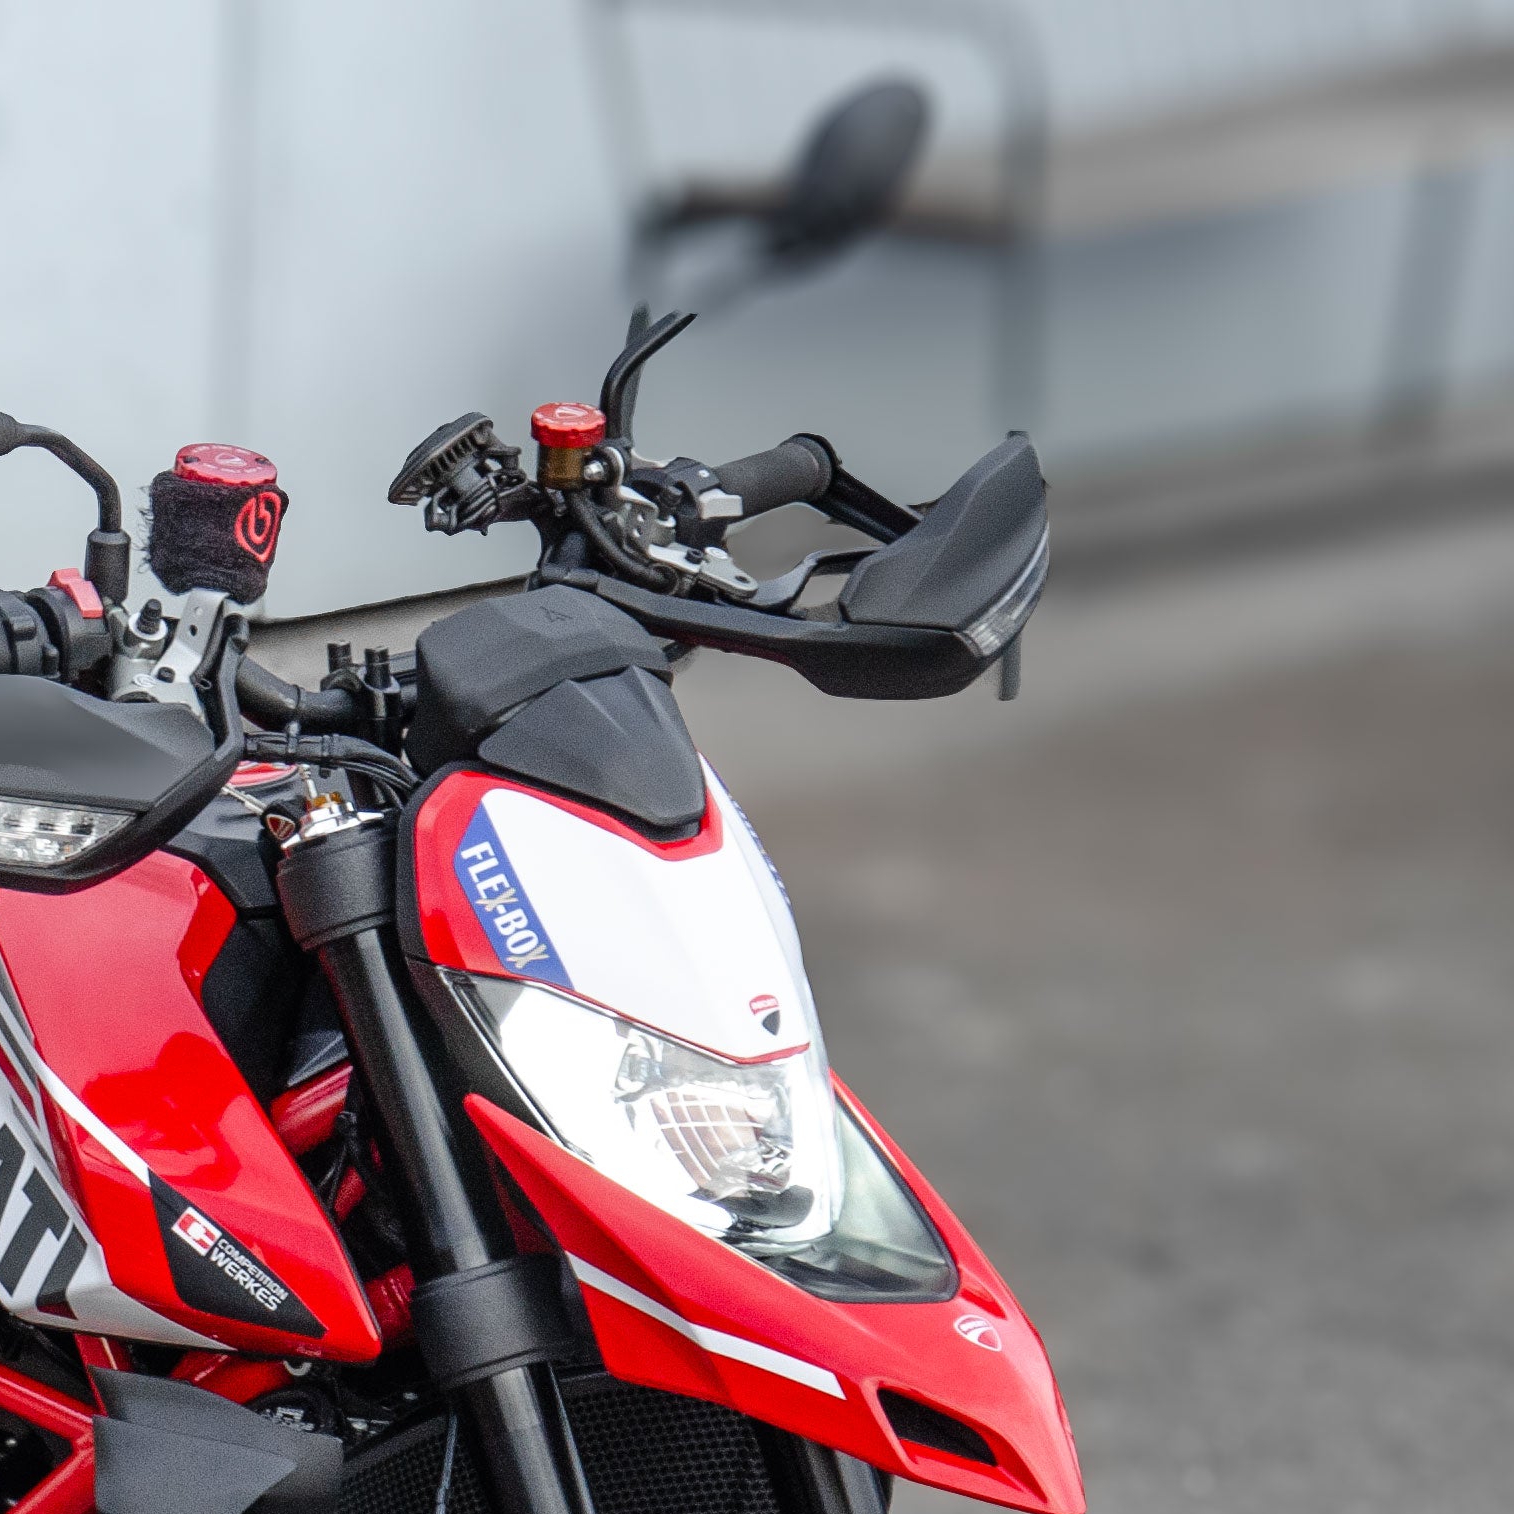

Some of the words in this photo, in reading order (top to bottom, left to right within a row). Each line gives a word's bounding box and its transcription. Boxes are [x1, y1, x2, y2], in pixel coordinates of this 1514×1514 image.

[461, 841, 550, 969] FLEX-BOX
[210, 1247, 282, 1311] WERKES
[217, 1238, 289, 1300] COMPETITION
